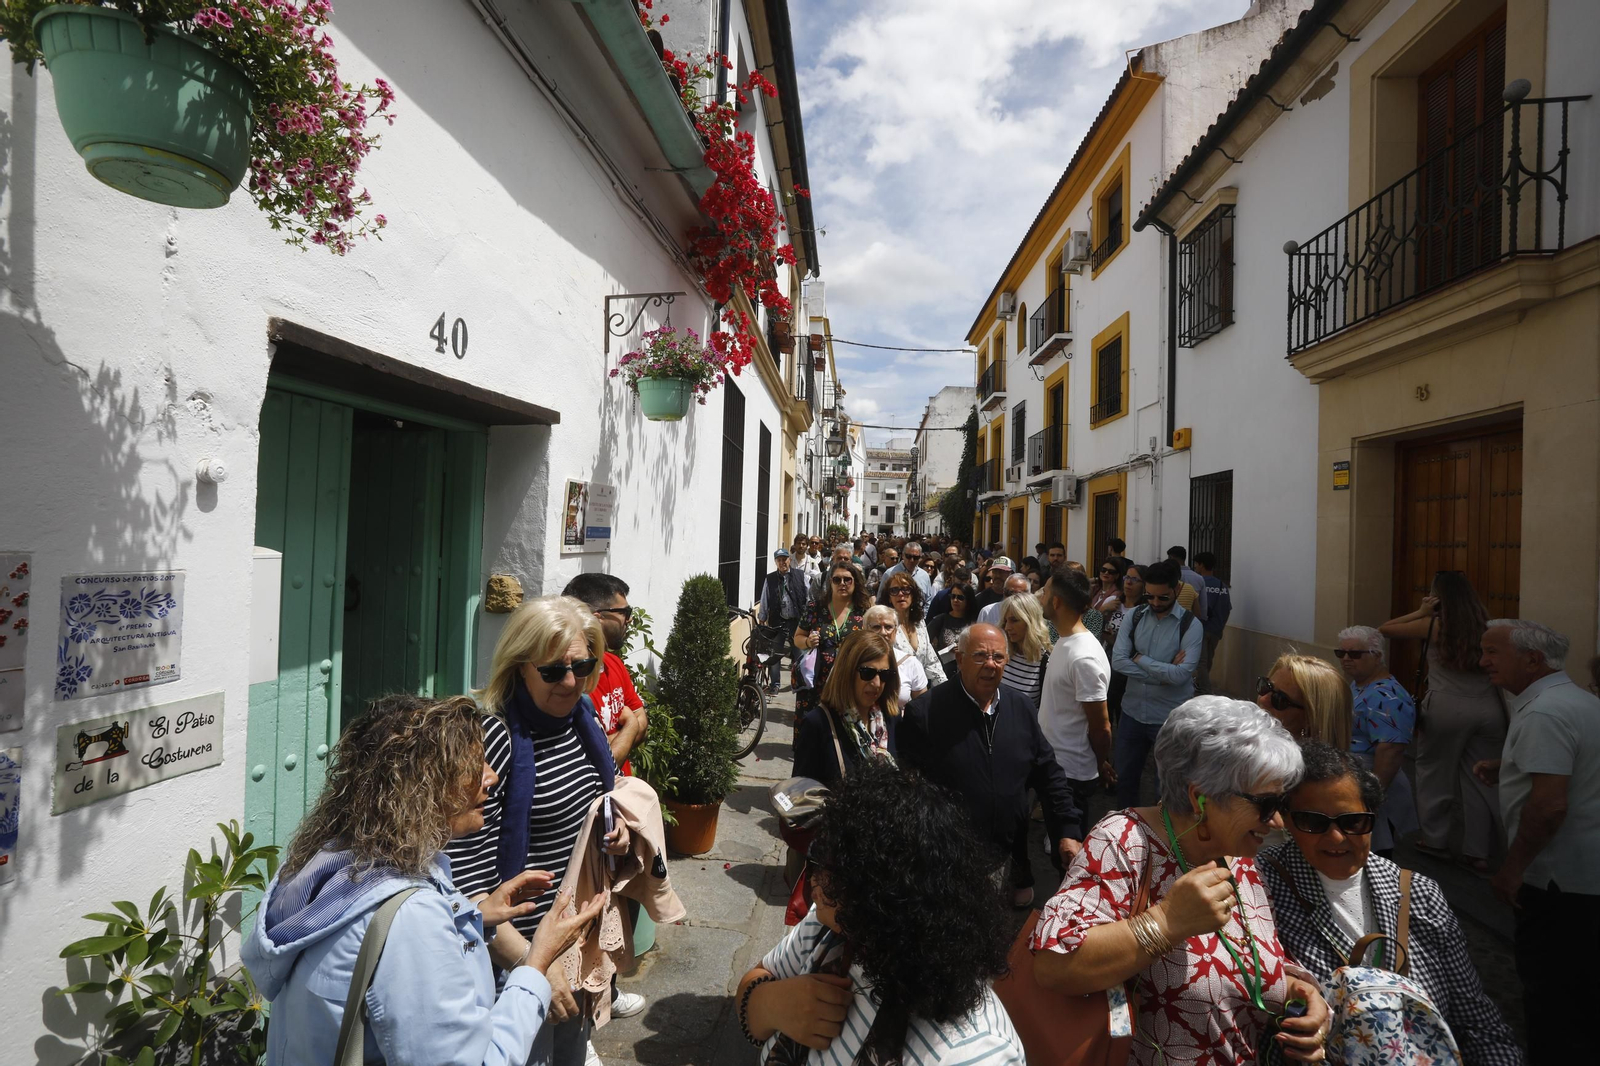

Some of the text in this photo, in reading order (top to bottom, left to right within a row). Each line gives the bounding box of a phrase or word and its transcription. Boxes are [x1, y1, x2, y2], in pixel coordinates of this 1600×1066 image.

[429, 311, 468, 360] 40
[74, 576, 120, 585] CONCURSO
[132, 575, 159, 583] PATIOS
[125, 622, 153, 630] PREMIO
[89, 630, 177, 645] ARQUITECTURA ANTIGUA
[113, 645, 127, 653] San
[149, 711, 215, 739] El Patio
[73, 742, 213, 794] de la Costurera
